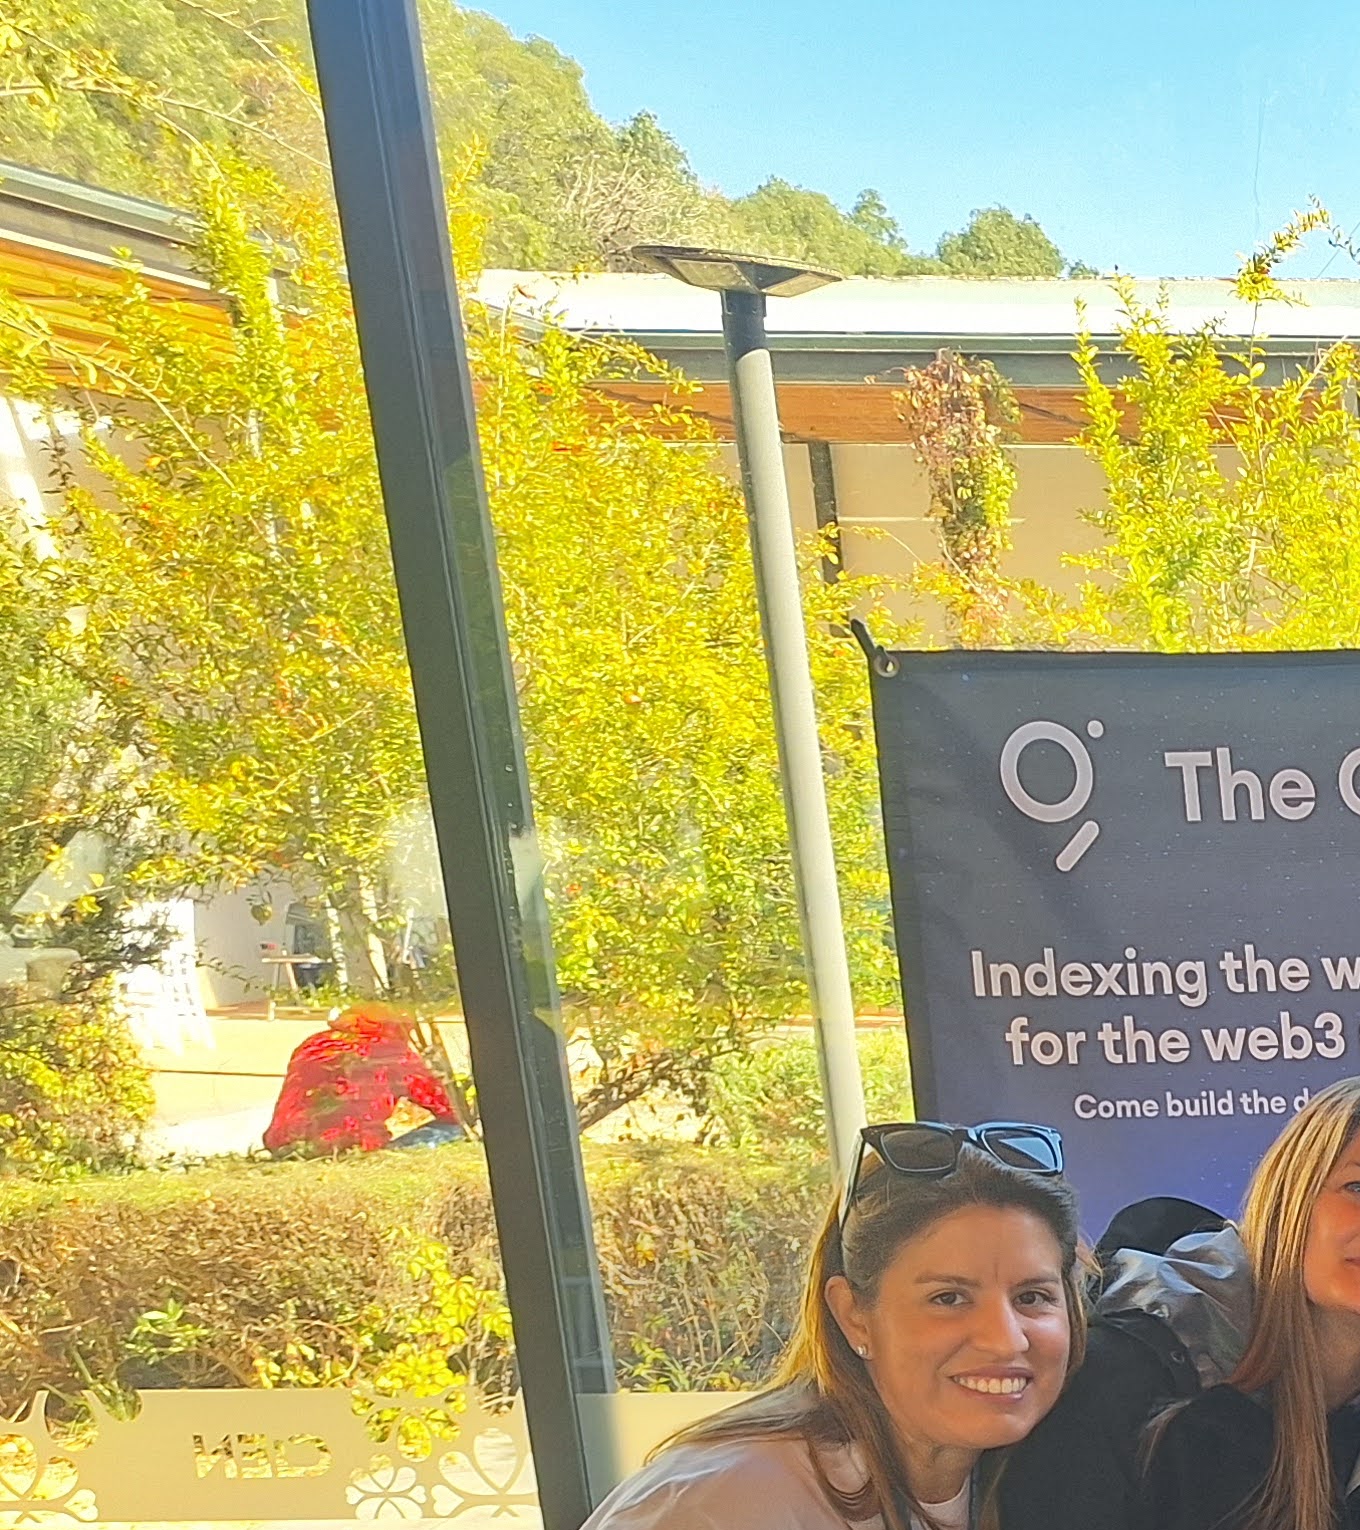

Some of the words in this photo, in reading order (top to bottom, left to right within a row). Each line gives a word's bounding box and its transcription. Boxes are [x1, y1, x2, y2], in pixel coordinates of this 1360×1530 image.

[1164, 748, 1316, 822] The
[970, 947, 1206, 1007] Indexing
[1220, 942, 1310, 994] the
[1005, 1017, 1088, 1066] for
[1097, 1015, 1191, 1064] the
[1199, 1012, 1346, 1061] web3
[1074, 1092, 1159, 1120] Come
[1166, 1087, 1236, 1119] build
[1240, 1086, 1287, 1116] the
